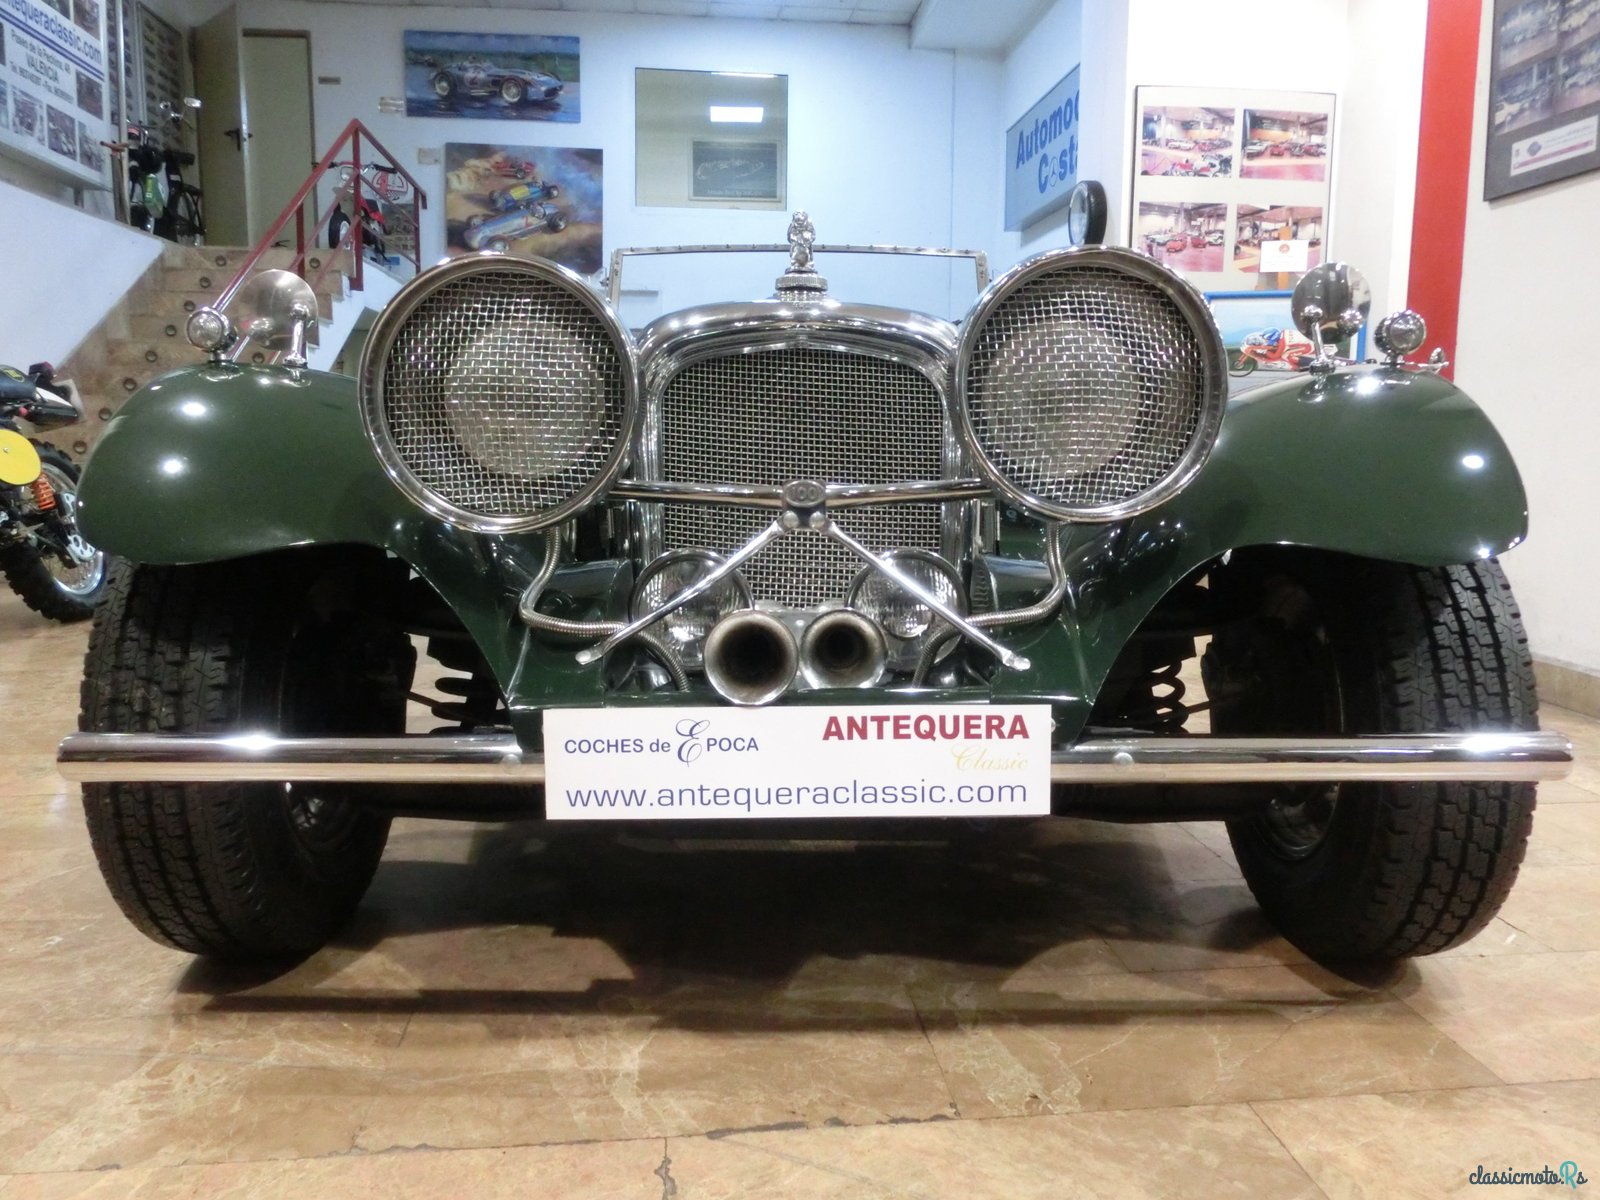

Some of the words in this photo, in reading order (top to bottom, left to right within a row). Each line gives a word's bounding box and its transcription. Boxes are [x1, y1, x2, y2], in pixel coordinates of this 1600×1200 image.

[822, 714, 1030, 741] ANTEQUERA
[564, 738, 644, 754] COCHES
[649, 738, 671, 753] de
[950, 745, 1029, 771] Classic
[566, 779, 1027, 812] www.antequeraclassic.com
